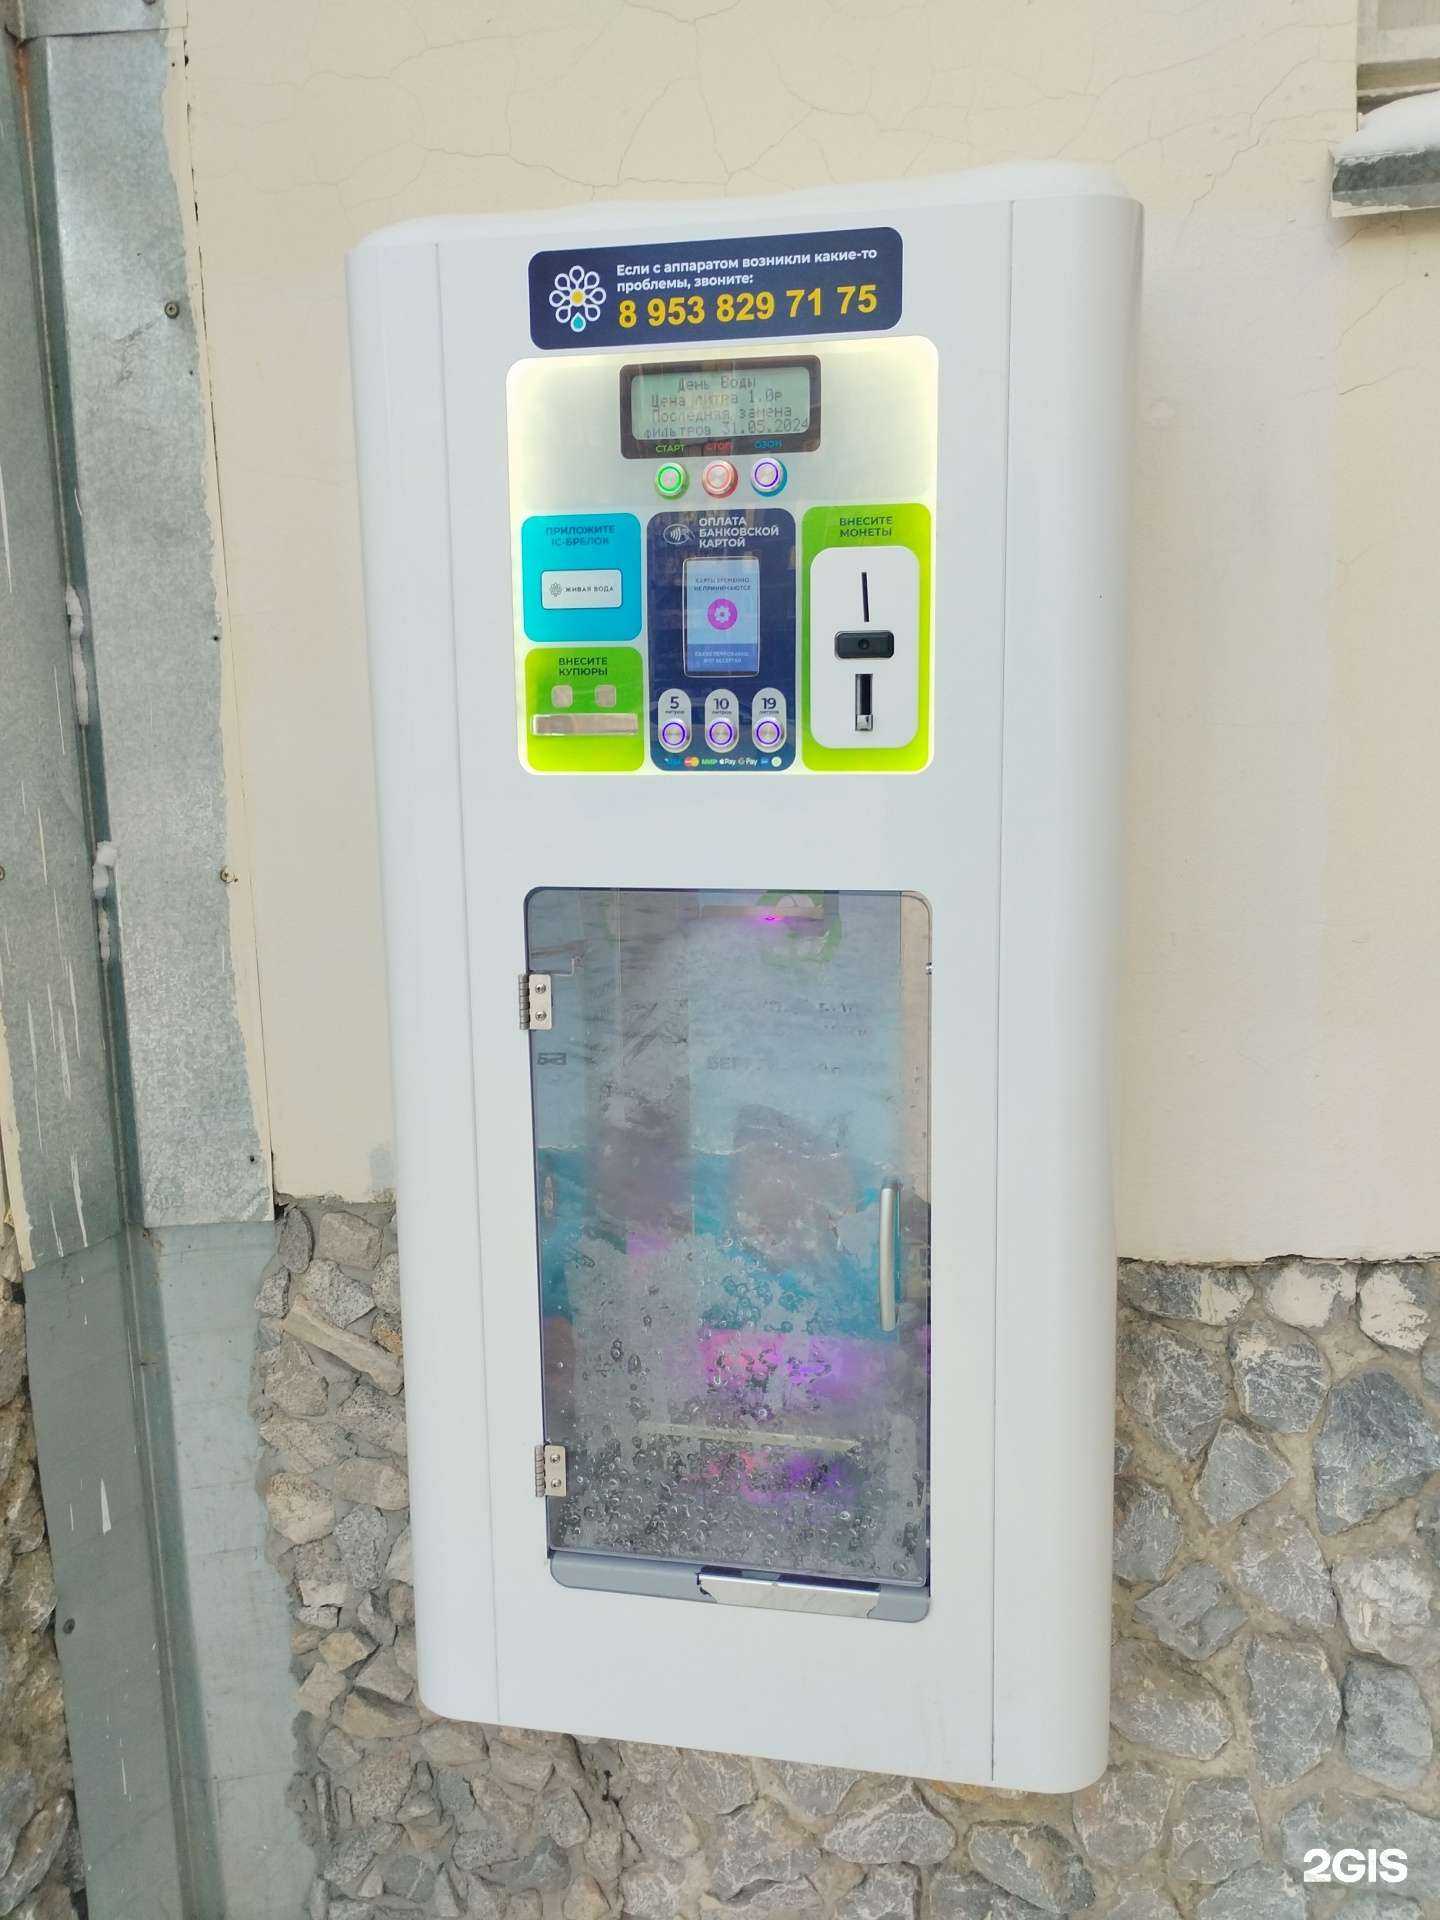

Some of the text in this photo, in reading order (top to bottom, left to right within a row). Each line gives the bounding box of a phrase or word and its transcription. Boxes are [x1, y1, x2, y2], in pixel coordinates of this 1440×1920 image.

[617, 249, 877, 276] Если с аппаратом возникли какие-то
[617, 274, 753, 294] проблемы, звоните:
[618, 284, 877, 329] 8 953 829 71 75
[678, 377, 711, 392] День
[651, 394, 686, 408] Цена
[739, 405, 792, 419] замена
[656, 443, 685, 453] СТАРТ
[699, 516, 747, 527] ОПЛАТА
[839, 515, 893, 527] ВНЕСИТЕ
[545, 524, 616, 536] ПРИЛОЖИТЕ
[699, 525, 779, 538] БАНКОВСКОЙ
[839, 527, 892, 538] МОНЕТЫ
[699, 537, 746, 548] КАРТОЙ
[565, 585, 614, 593] ЖИВАЯ ВОДА
[558, 656, 608, 666] ВНЕСИТЕ
[559, 667, 608, 676] КУПЮРЫ
[670, 696, 680, 710] 5
[713, 697, 730, 710] 10
[761, 697, 777, 710] 19
